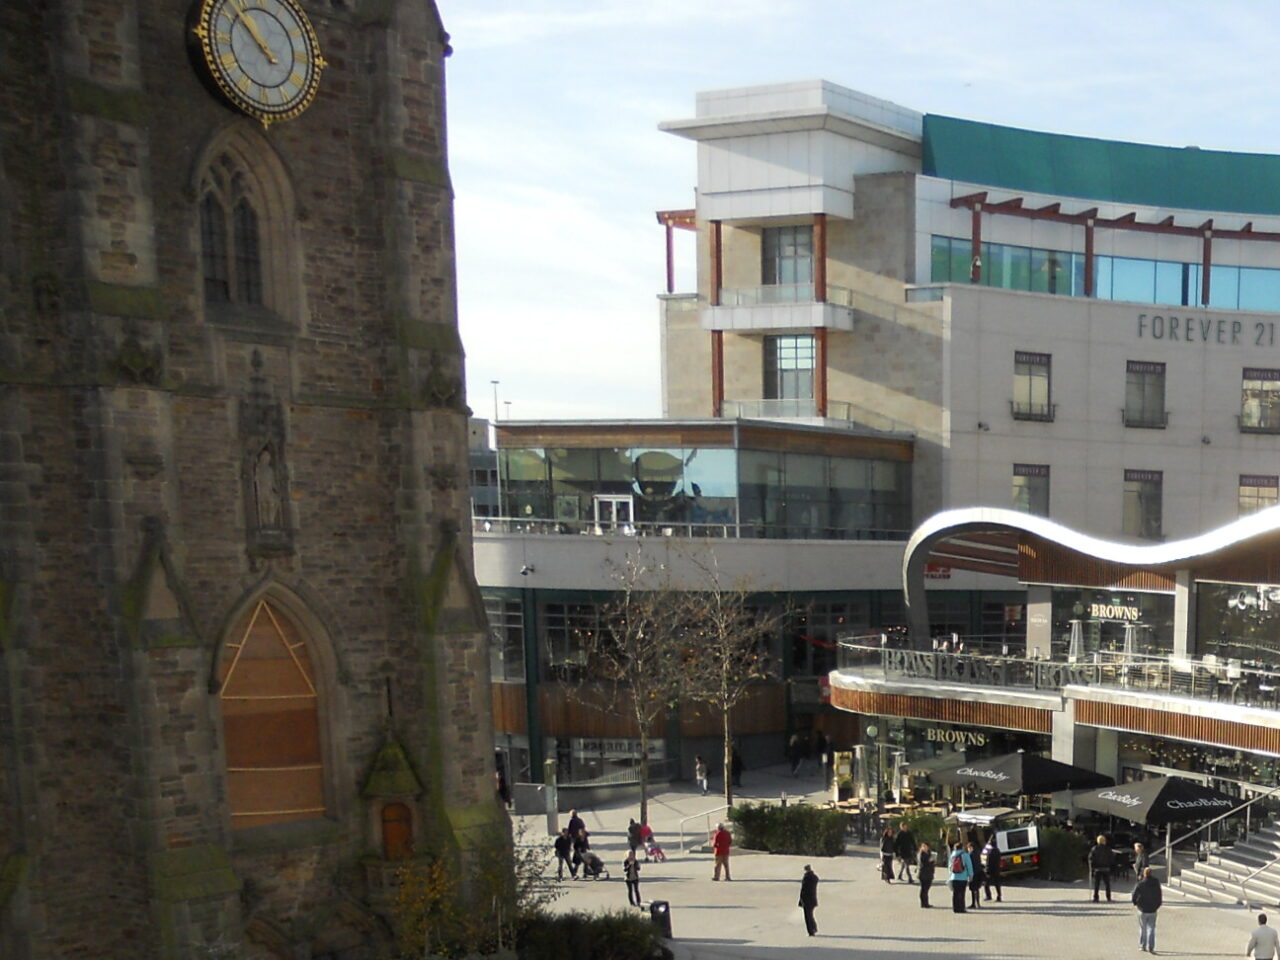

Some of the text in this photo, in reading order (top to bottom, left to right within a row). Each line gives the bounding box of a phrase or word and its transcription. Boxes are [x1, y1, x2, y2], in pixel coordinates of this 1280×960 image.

[1138, 313, 1275, 346] FOREVER 21
[1091, 603, 1138, 621] BROWNS
[927, 728, 985, 747] BROWNS
[1166, 797, 1233, 810] ChaoBaby
